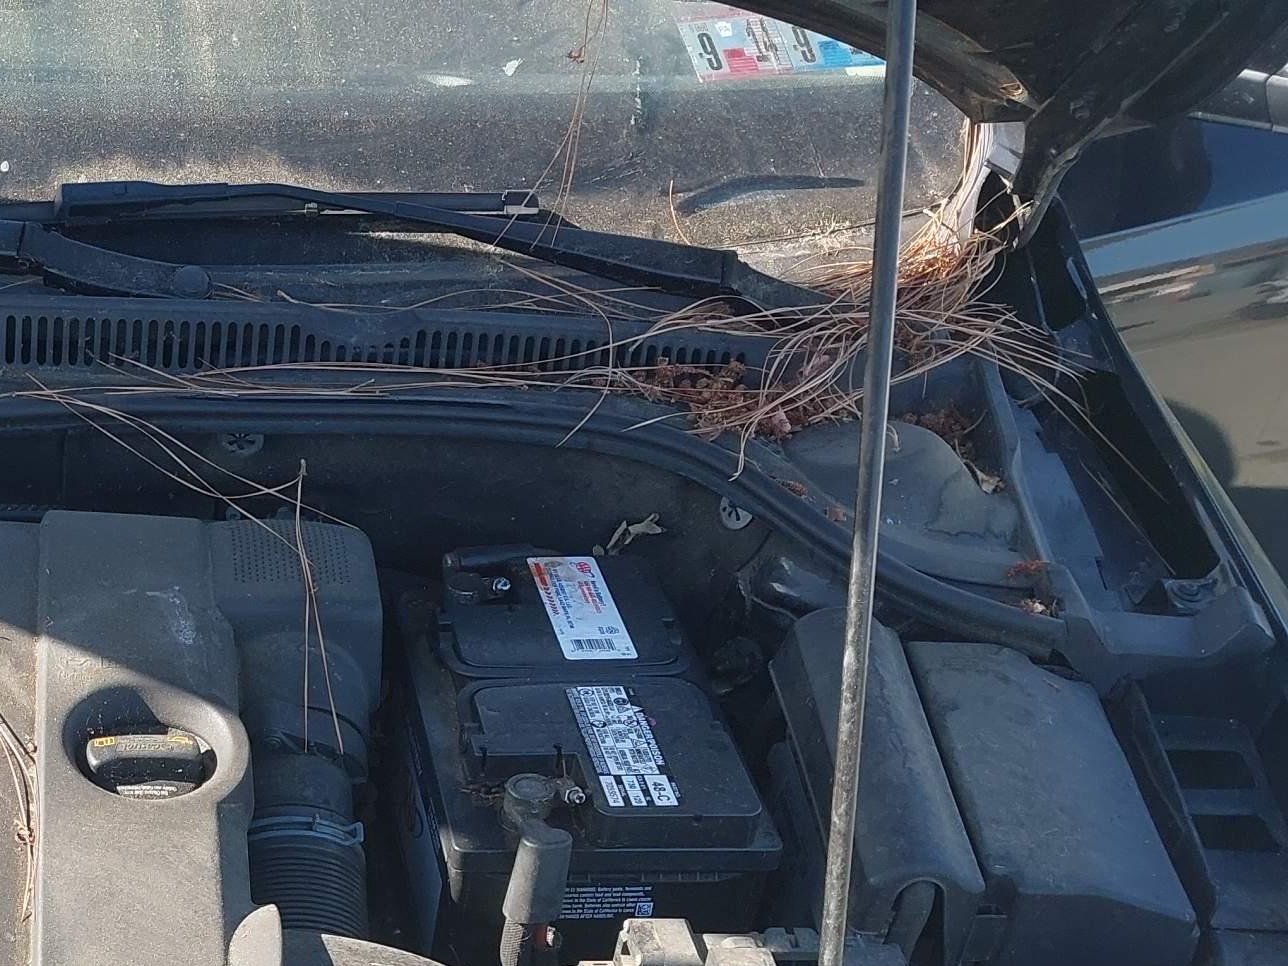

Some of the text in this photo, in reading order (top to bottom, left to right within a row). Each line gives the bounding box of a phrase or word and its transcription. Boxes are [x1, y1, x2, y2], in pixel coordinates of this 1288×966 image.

[635, 712, 665, 766] DANGER POISON
[652, 782, 671, 802] 48-C
